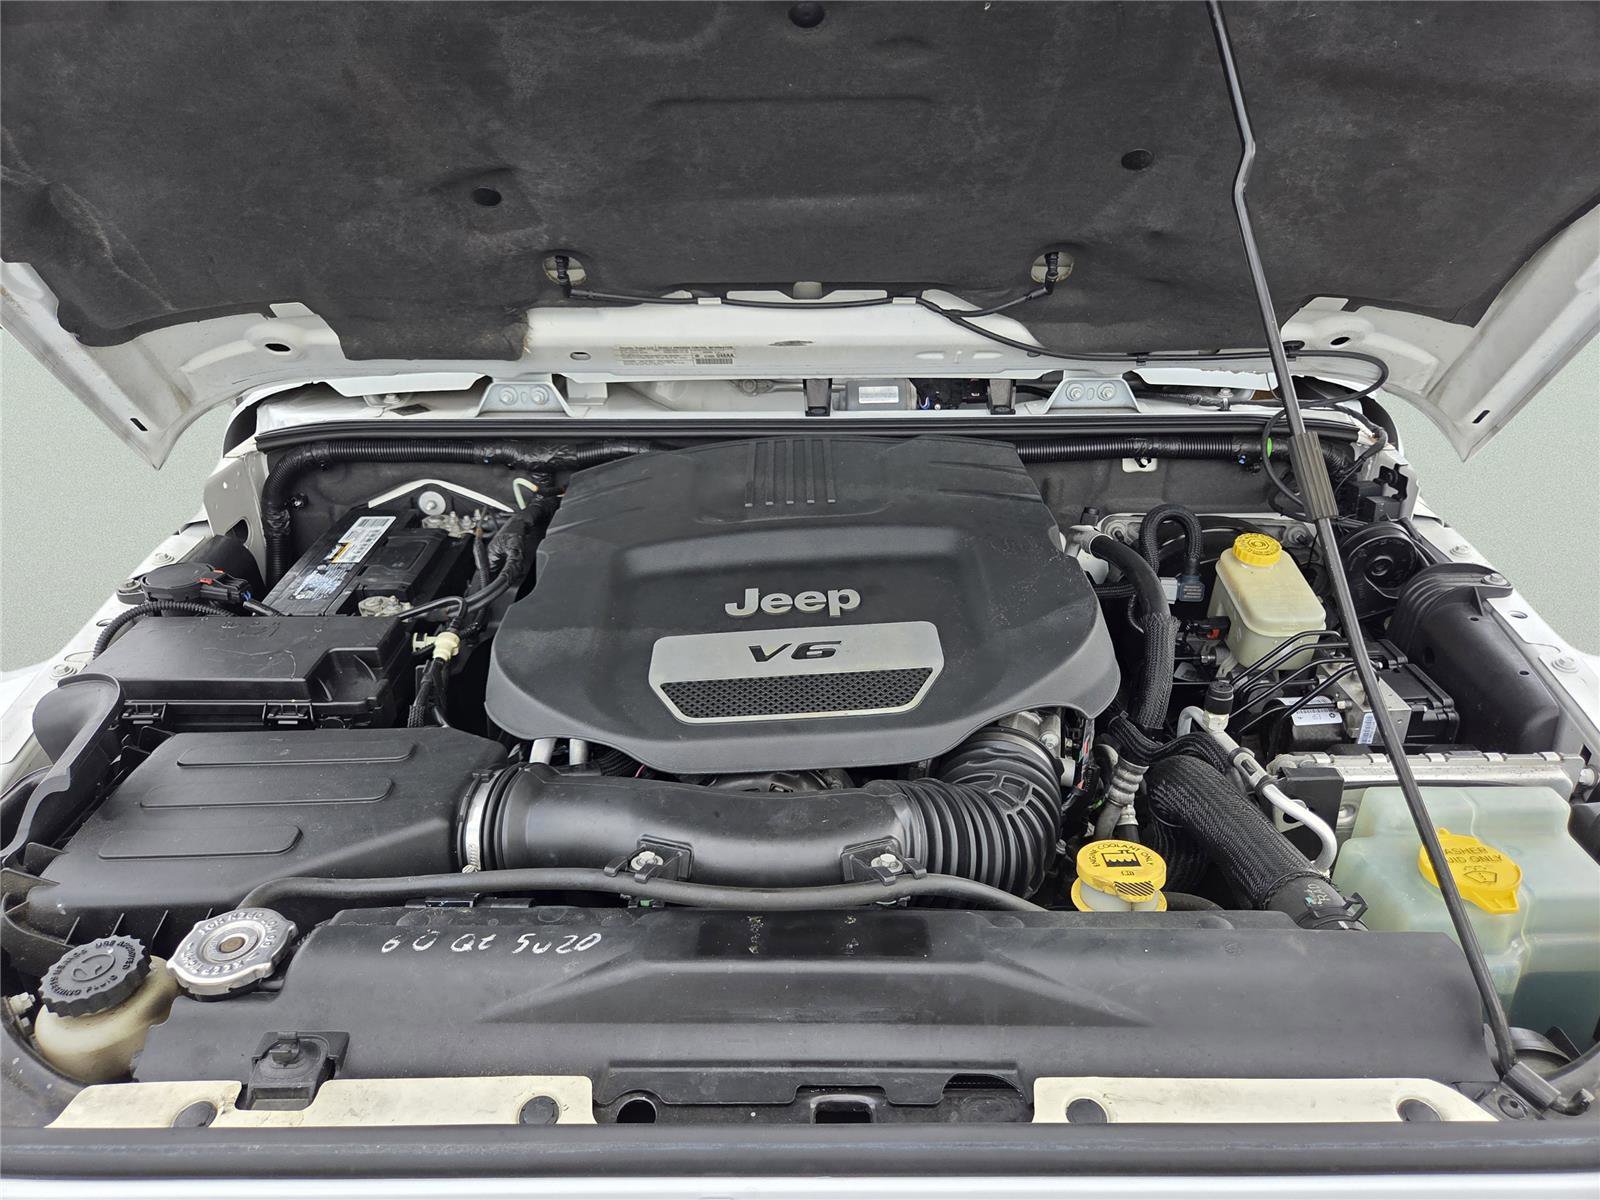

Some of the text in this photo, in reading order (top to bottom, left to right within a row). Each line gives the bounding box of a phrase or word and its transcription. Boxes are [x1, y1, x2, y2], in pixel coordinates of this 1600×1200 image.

[725, 587, 860, 618] Jeep
[748, 640, 842, 663] V6
[1097, 843, 1141, 852] COOLANT
[1140, 852, 1154, 866] ONLY
[1444, 846, 1488, 855] ASHER
[1469, 854, 1503, 863] ONLY
